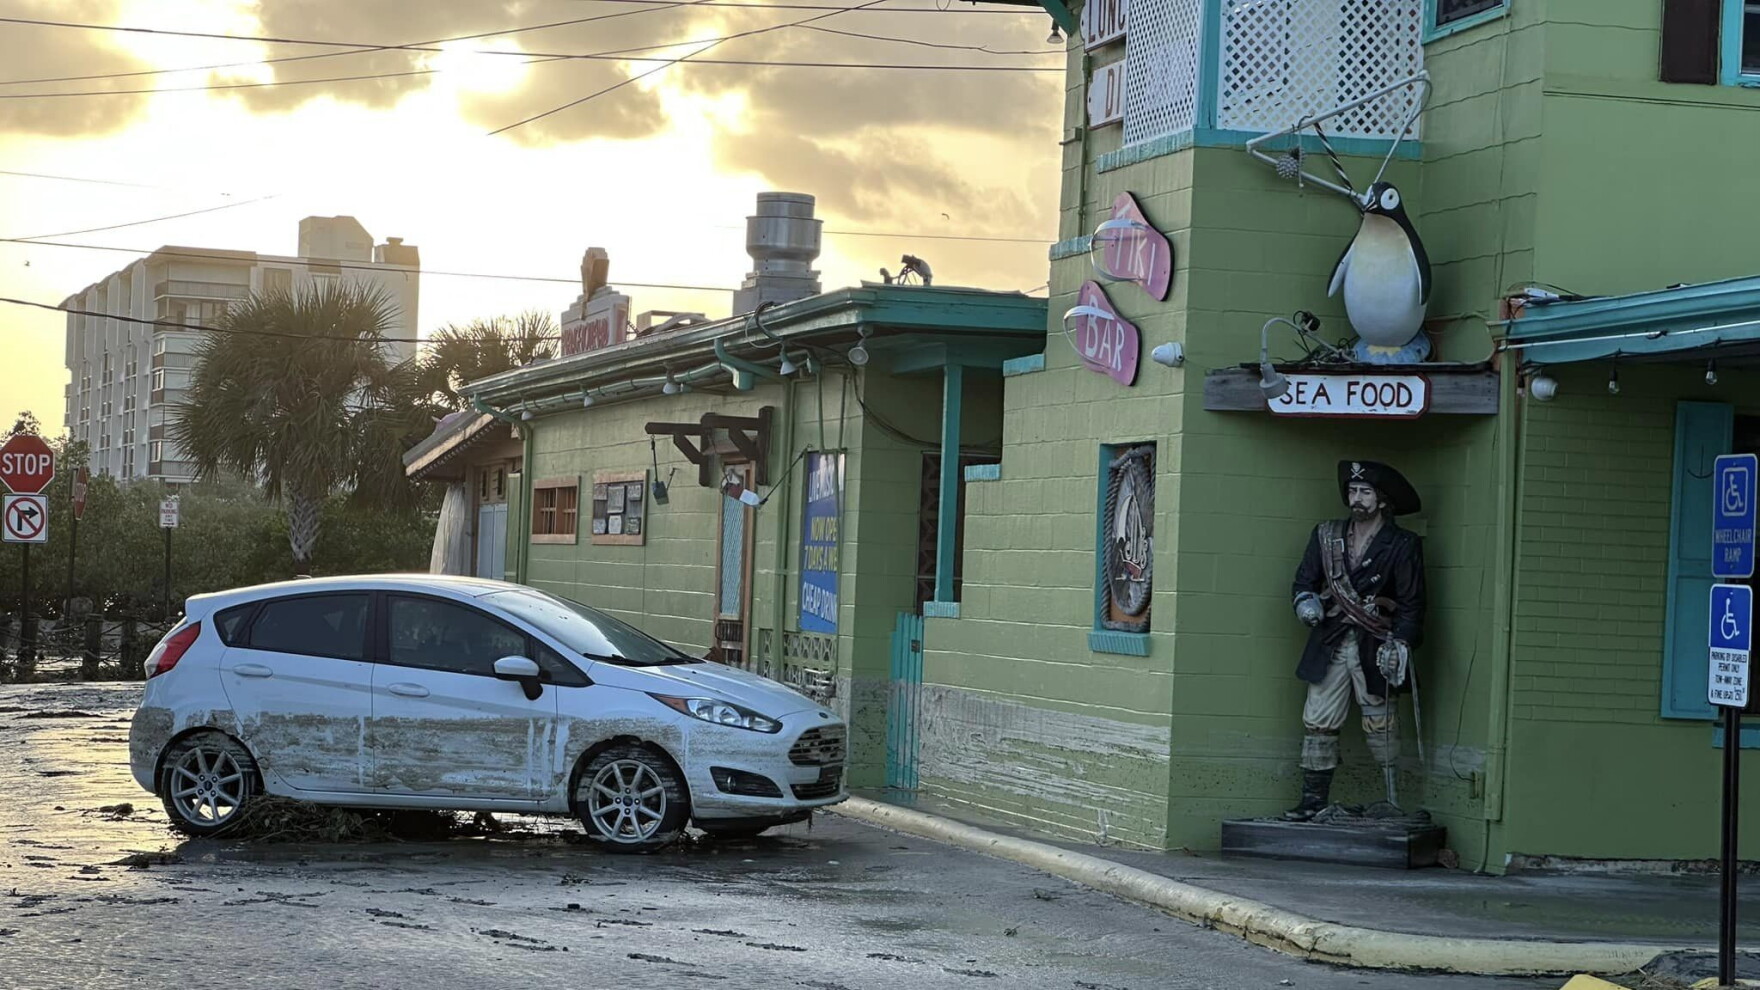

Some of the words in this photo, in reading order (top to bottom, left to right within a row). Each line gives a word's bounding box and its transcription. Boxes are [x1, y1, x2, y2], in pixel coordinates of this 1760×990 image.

[1115, 203, 1156, 286] TIKI
[1084, 294, 1126, 372] BAR
[1279, 381, 1331, 406] SEA
[1346, 380, 1413, 408] FOOD
[2, 452, 50, 475] STOP
[811, 516, 825, 542] NOW
[1715, 528, 1752, 544] WHEELCHAIR
[803, 545, 809, 570] 7
[808, 545, 823, 571] DAYS
[1724, 547, 1742, 563] RAMP
[802, 581, 821, 616] CHEAP
[1711, 651, 1726, 661] PARKING
[1731, 653, 1747, 663] DISABLED
[1718, 662, 1730, 672] PERMIT
